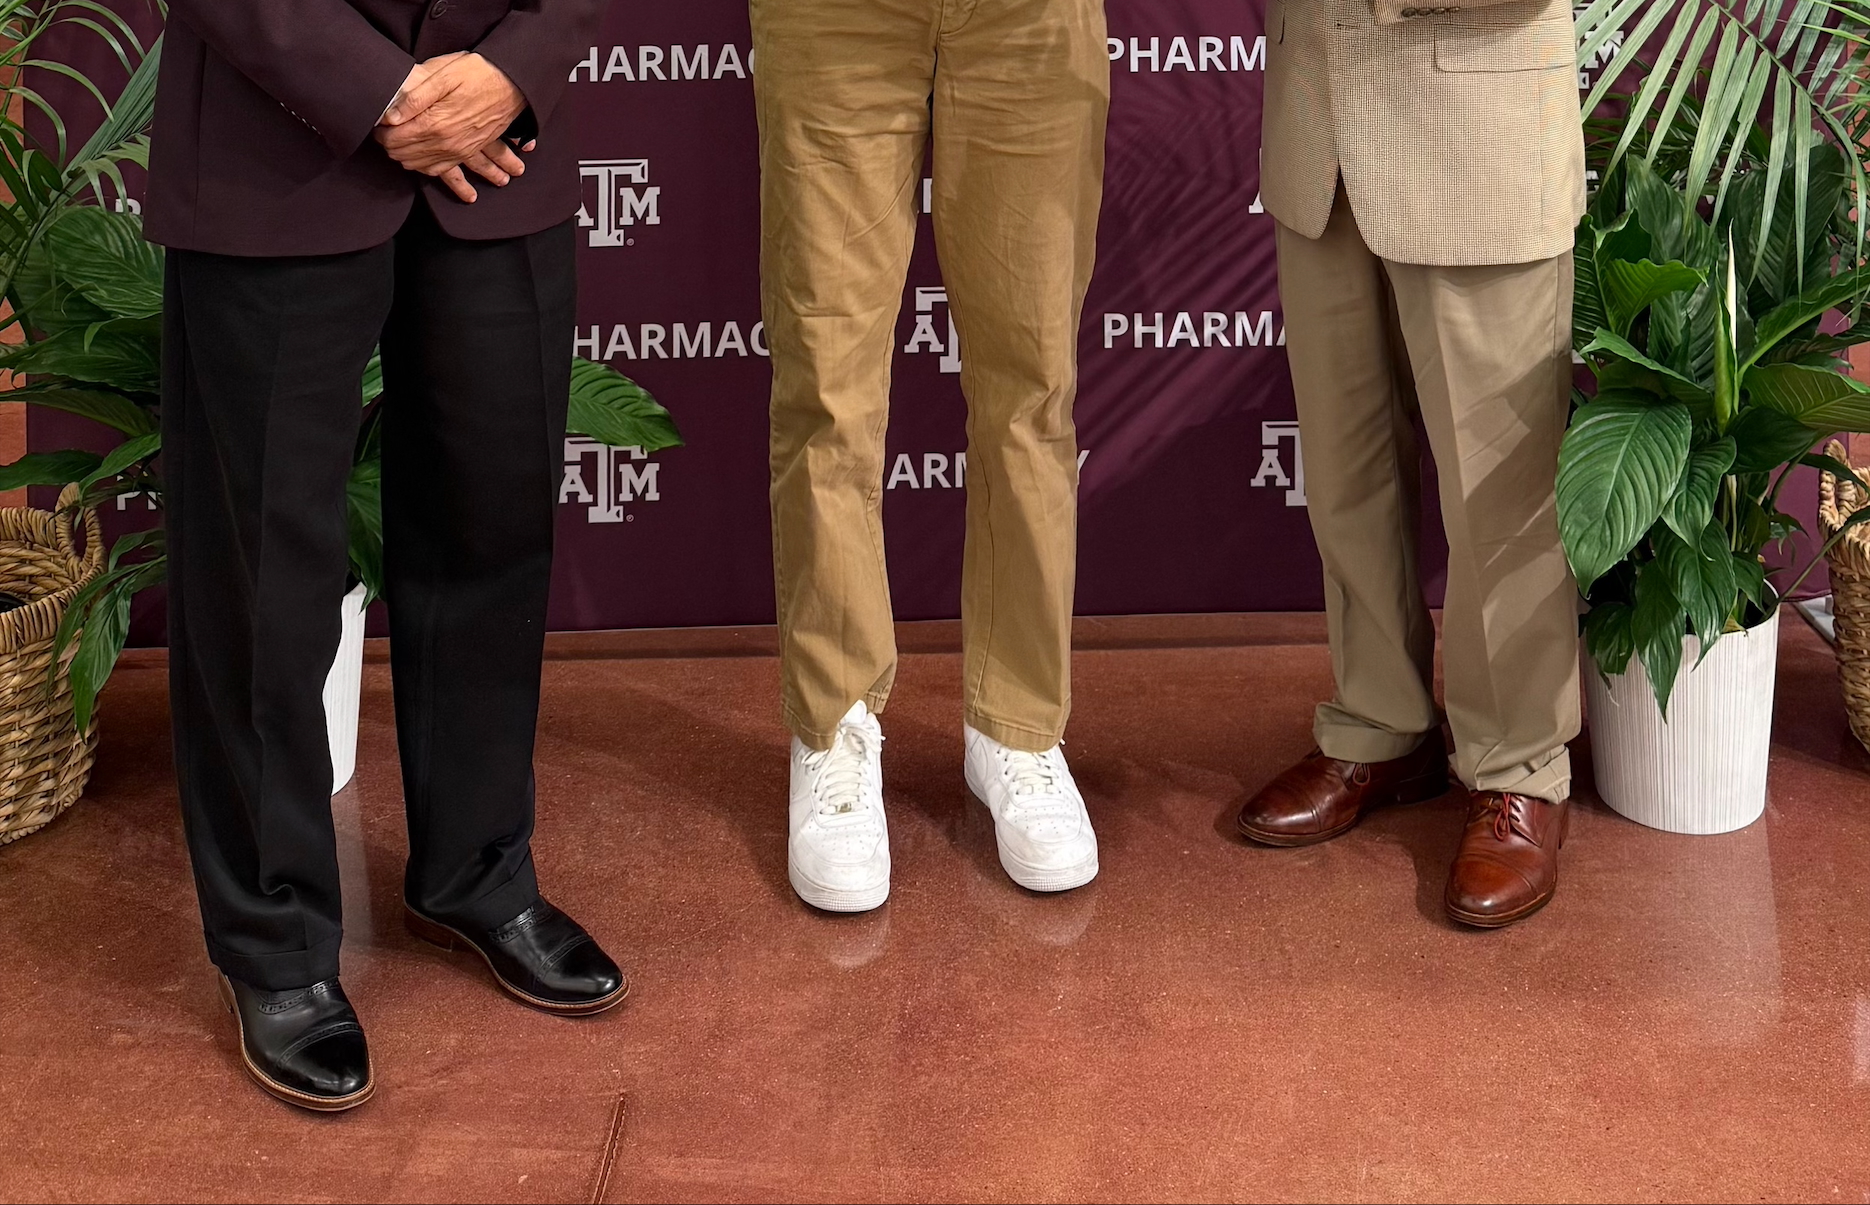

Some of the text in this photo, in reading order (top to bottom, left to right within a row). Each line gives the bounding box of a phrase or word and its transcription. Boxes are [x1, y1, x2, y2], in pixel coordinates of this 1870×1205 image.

[567, 43, 755, 83] HARMA
[1106, 35, 1268, 73] PHARM
[572, 320, 771, 361] HARMAC
[1102, 311, 1286, 349] PHARM
